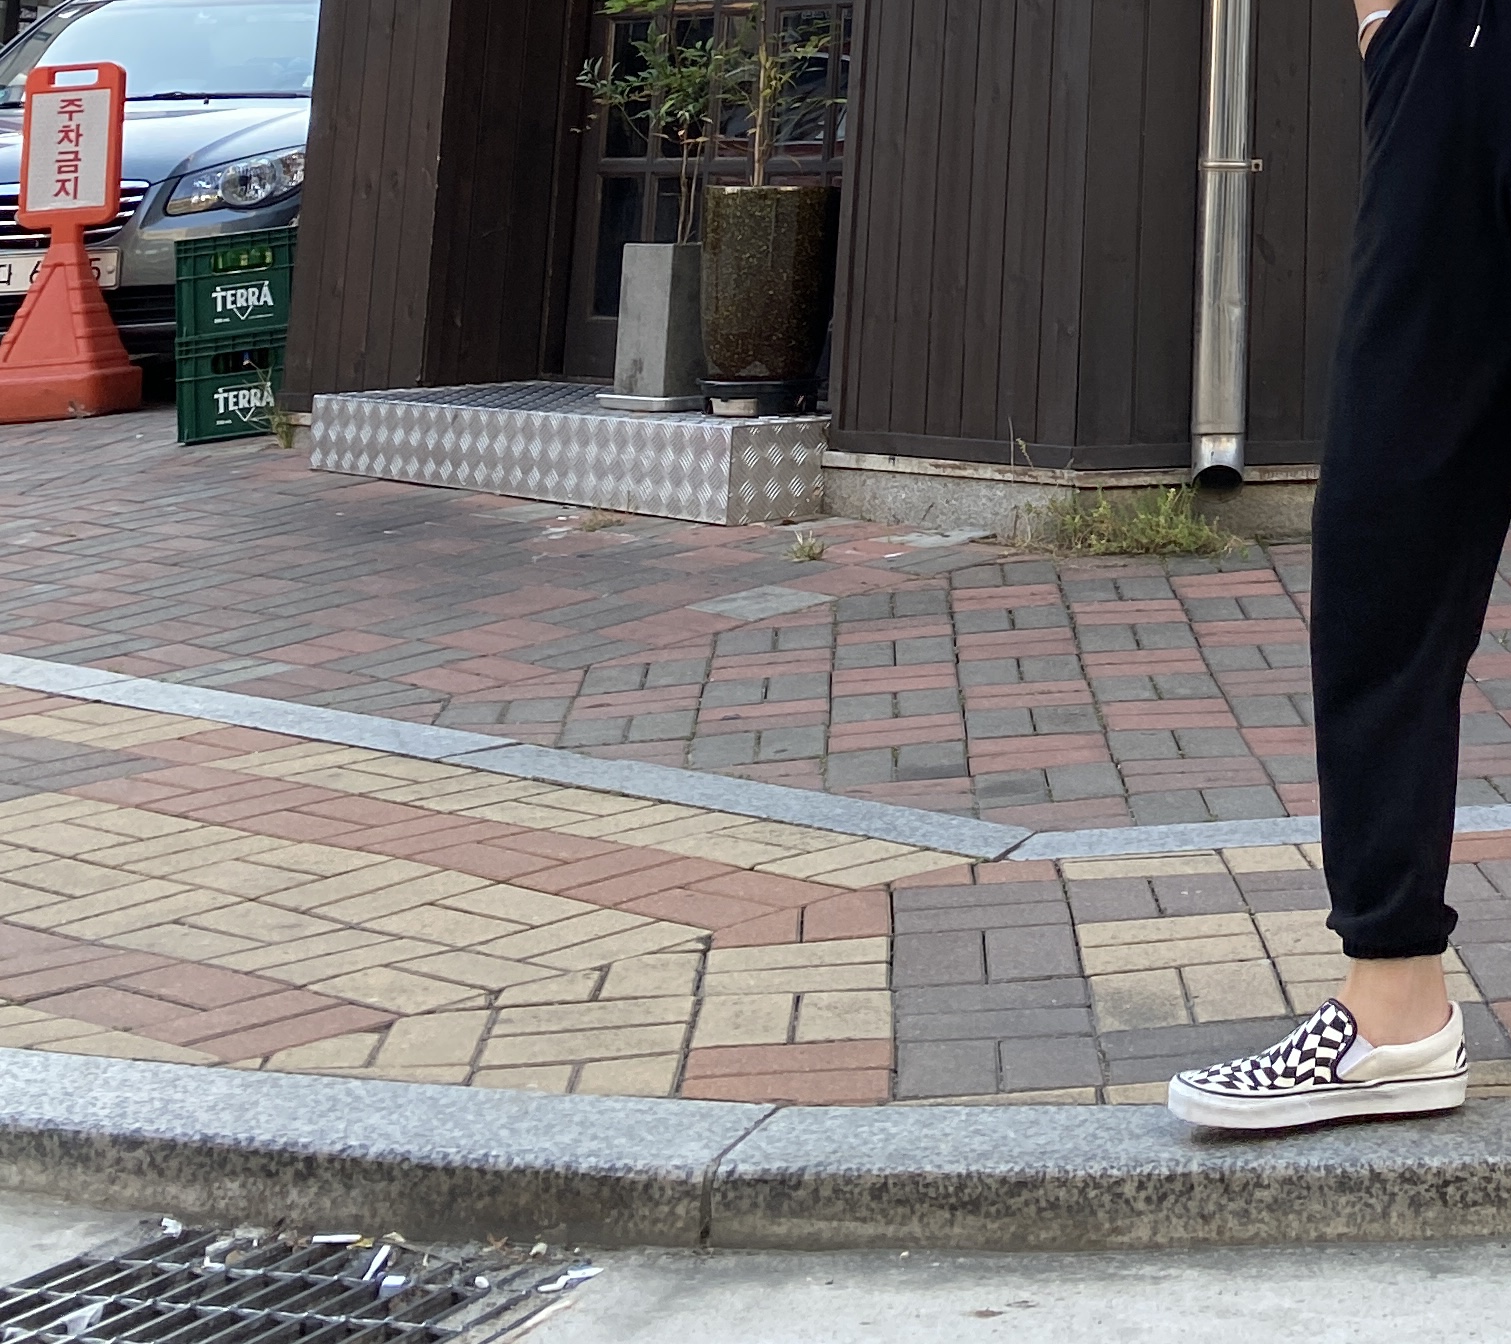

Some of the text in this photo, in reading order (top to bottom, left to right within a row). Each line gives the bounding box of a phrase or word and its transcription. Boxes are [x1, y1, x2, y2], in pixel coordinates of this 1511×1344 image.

[53, 97, 84, 201] 주차금지
[29, 258, 102, 284] 65
[211, 282, 274, 313] TERRA
[213, 383, 275, 415] TERRA
